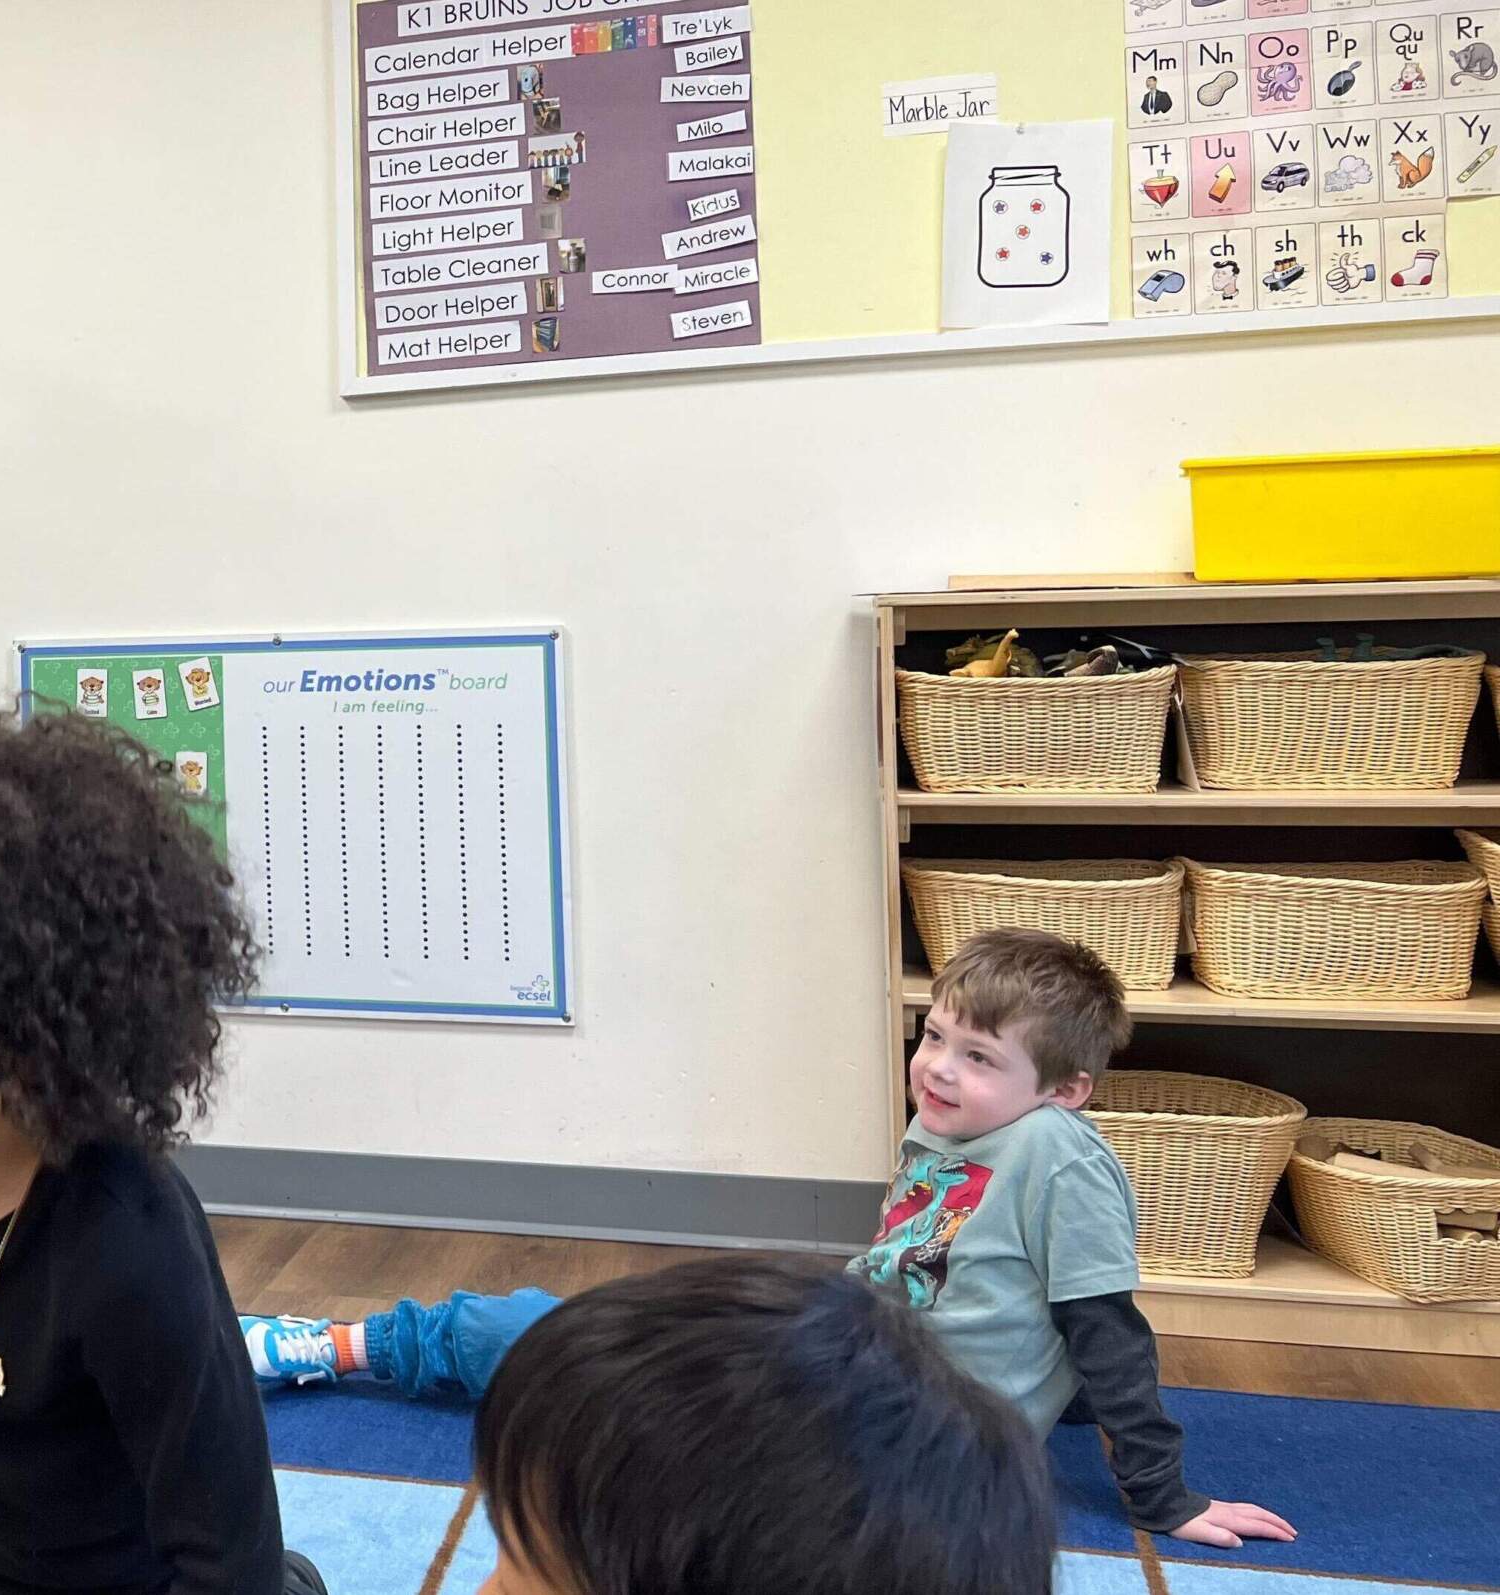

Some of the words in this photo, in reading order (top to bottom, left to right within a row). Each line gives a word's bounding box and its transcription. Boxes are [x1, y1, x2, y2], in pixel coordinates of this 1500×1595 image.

[407, 7, 432, 29] K1
[444, 0, 529, 25] BRUINS
[672, 16, 733, 36] Tre'Lyk
[1389, 23, 1424, 43] Qu
[1457, 16, 1484, 40] Rr
[374, 46, 480, 74] Calendar
[492, 34, 567, 57] Helper
[685, 44, 739, 66] Bailey
[1199, 42, 1233, 66] Nn
[1258, 36, 1299, 59] Oo
[1395, 44, 1418, 61] qu
[1132, 49, 1177, 73] Mm
[377, 93, 420, 111] Bag
[427, 81, 500, 105] Helper
[671, 81, 743, 98] Nevaeh
[889, 95, 949, 125] Marble
[956, 90, 991, 118] Jar
[377, 122, 437, 146] Chair
[443, 116, 517, 139] Helper
[687, 121, 724, 139] Milo
[1322, 125, 1371, 150] Ww
[1393, 120, 1429, 145] Xx
[1459, 114, 1492, 146] Yy
[1142, 143, 1172, 166] Tt
[1204, 138, 1237, 160] Uu
[1266, 131, 1301, 154] Vv
[379, 158, 422, 178] Line
[429, 149, 509, 172] Leader
[678, 152, 751, 174] Malakai
[380, 193, 432, 213] Floor
[438, 183, 525, 207] Monitor
[690, 194, 738, 217] Kidus
[382, 227, 434, 252] Light
[441, 220, 515, 242] Helper
[676, 225, 746, 252] Andrew
[1274, 229, 1297, 253] sh
[1337, 224, 1363, 248] th
[1401, 219, 1427, 243] ck
[1146, 238, 1176, 262] wh
[1209, 234, 1235, 257] ch
[381, 263, 441, 286] Table
[448, 255, 540, 278] Cleaner
[602, 271, 670, 289] Connor
[684, 265, 751, 289] Miracle
[385, 303, 438, 324] Door
[445, 294, 518, 317] Helper
[681, 310, 745, 332] Steven
[387, 338, 431, 360] Mat
[438, 332, 512, 354] Helper
[262, 679, 297, 694] our
[449, 672, 509, 690] board
[333, 701, 338, 712] I
[342, 703, 366, 713] am
[516, 990, 552, 1002] ecsel
